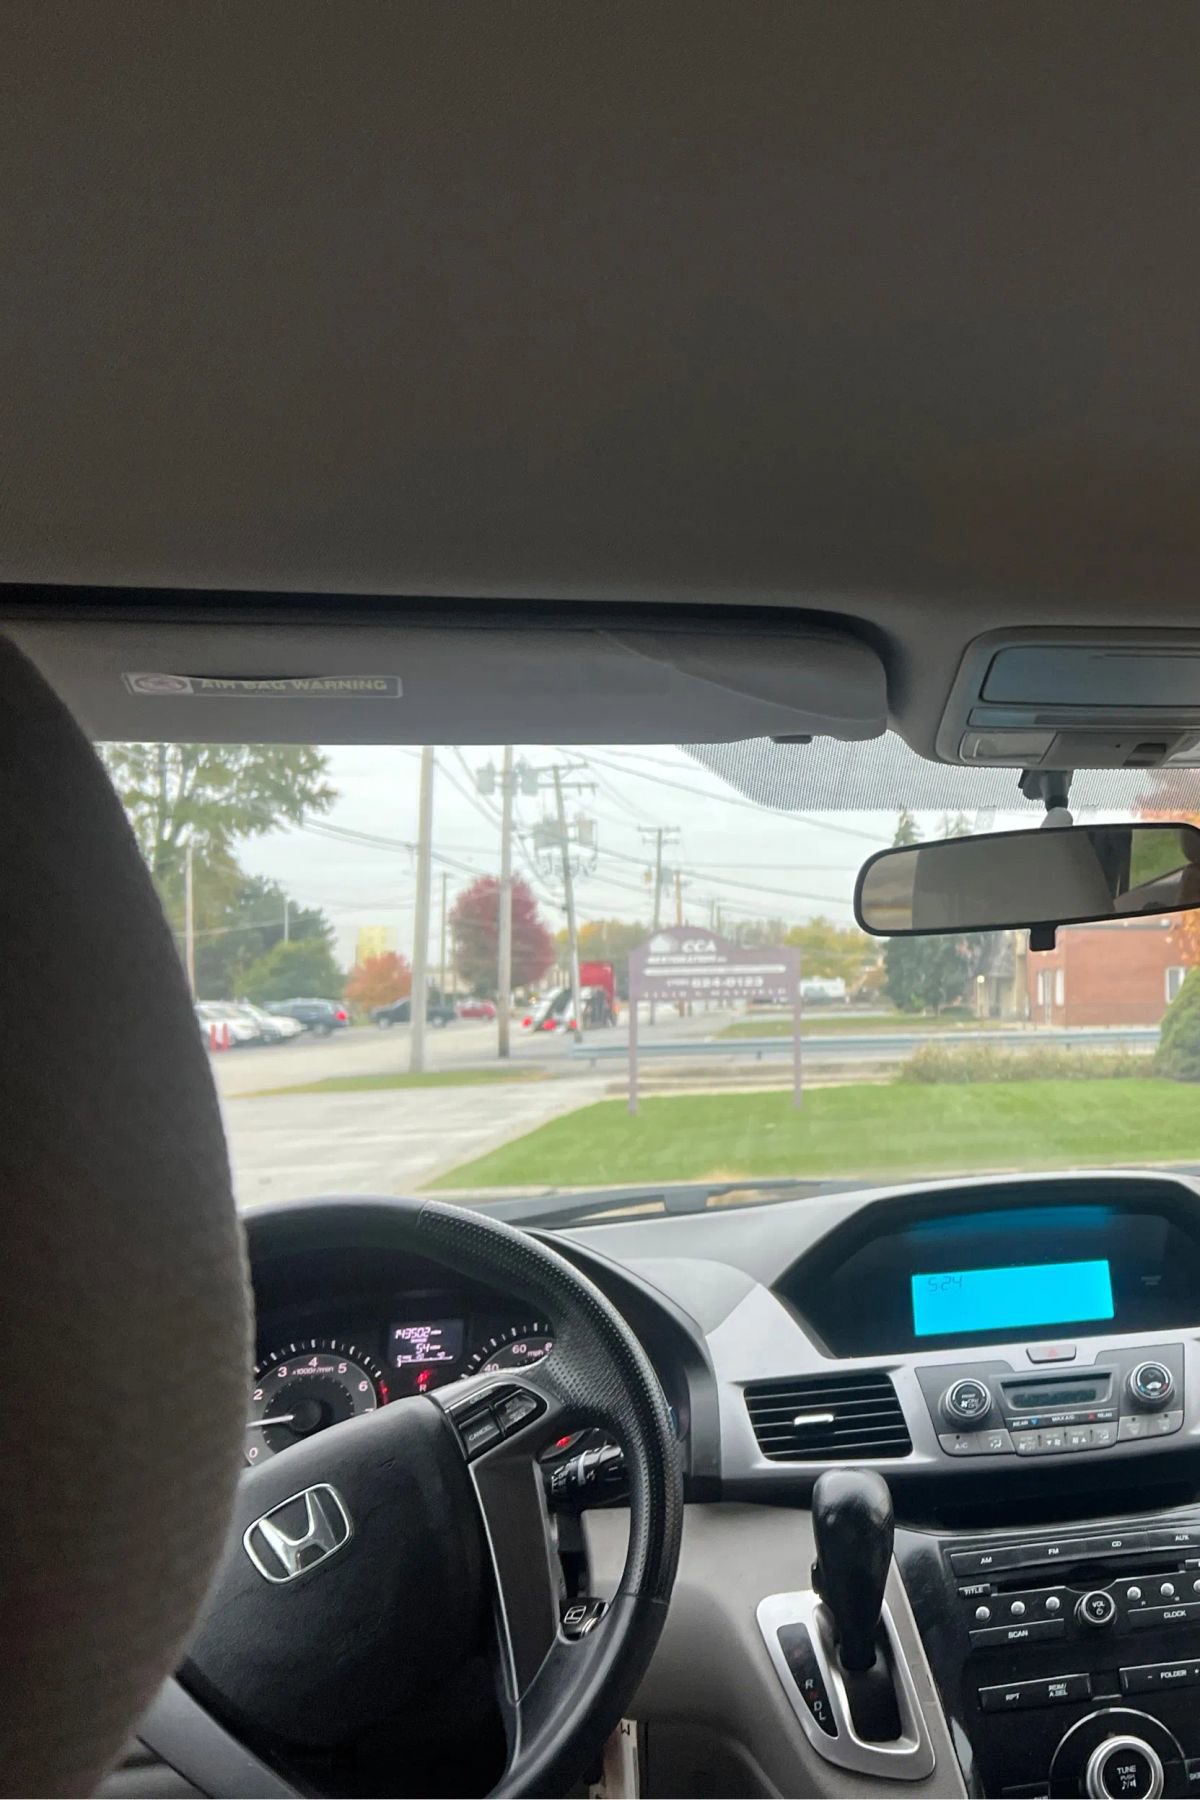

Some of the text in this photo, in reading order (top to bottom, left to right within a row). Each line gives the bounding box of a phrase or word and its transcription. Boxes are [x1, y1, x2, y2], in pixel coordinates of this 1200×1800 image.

[293, 678, 387, 691] WARNING
[682, 939, 717, 953] CCA
[395, 1326, 431, 1339] 143502
[512, 1344, 527, 1354] 60
[527, 1349, 544, 1358] mph
[308, 1357, 318, 1367] 4
[277, 1366, 288, 1377] 3
[338, 1363, 347, 1374] 5
[484, 1363, 499, 1372] 40
[358, 1381, 368, 1392] 6
[253, 1388, 263, 1400] 2
[954, 1442, 969, 1450] A/C
[249, 1447, 258, 1458] 0
[1175, 1534, 1189, 1542] AUX
[1111, 1540, 1122, 1548] CD
[1048, 1547, 1059, 1555] FM
[980, 1557, 993, 1565] AM
[964, 1587, 984, 1596] TITLE
[1092, 1600, 1106, 1608] VOL
[1163, 1609, 1186, 1618] CLOCK
[1008, 1630, 1029, 1639] SCAN
[1160, 1669, 1187, 1679] FOLDER
[805, 1679, 814, 1690] R
[814, 1701, 823, 1711] D
[819, 1711, 826, 1721] L
[1116, 1764, 1137, 1775] TUNE
